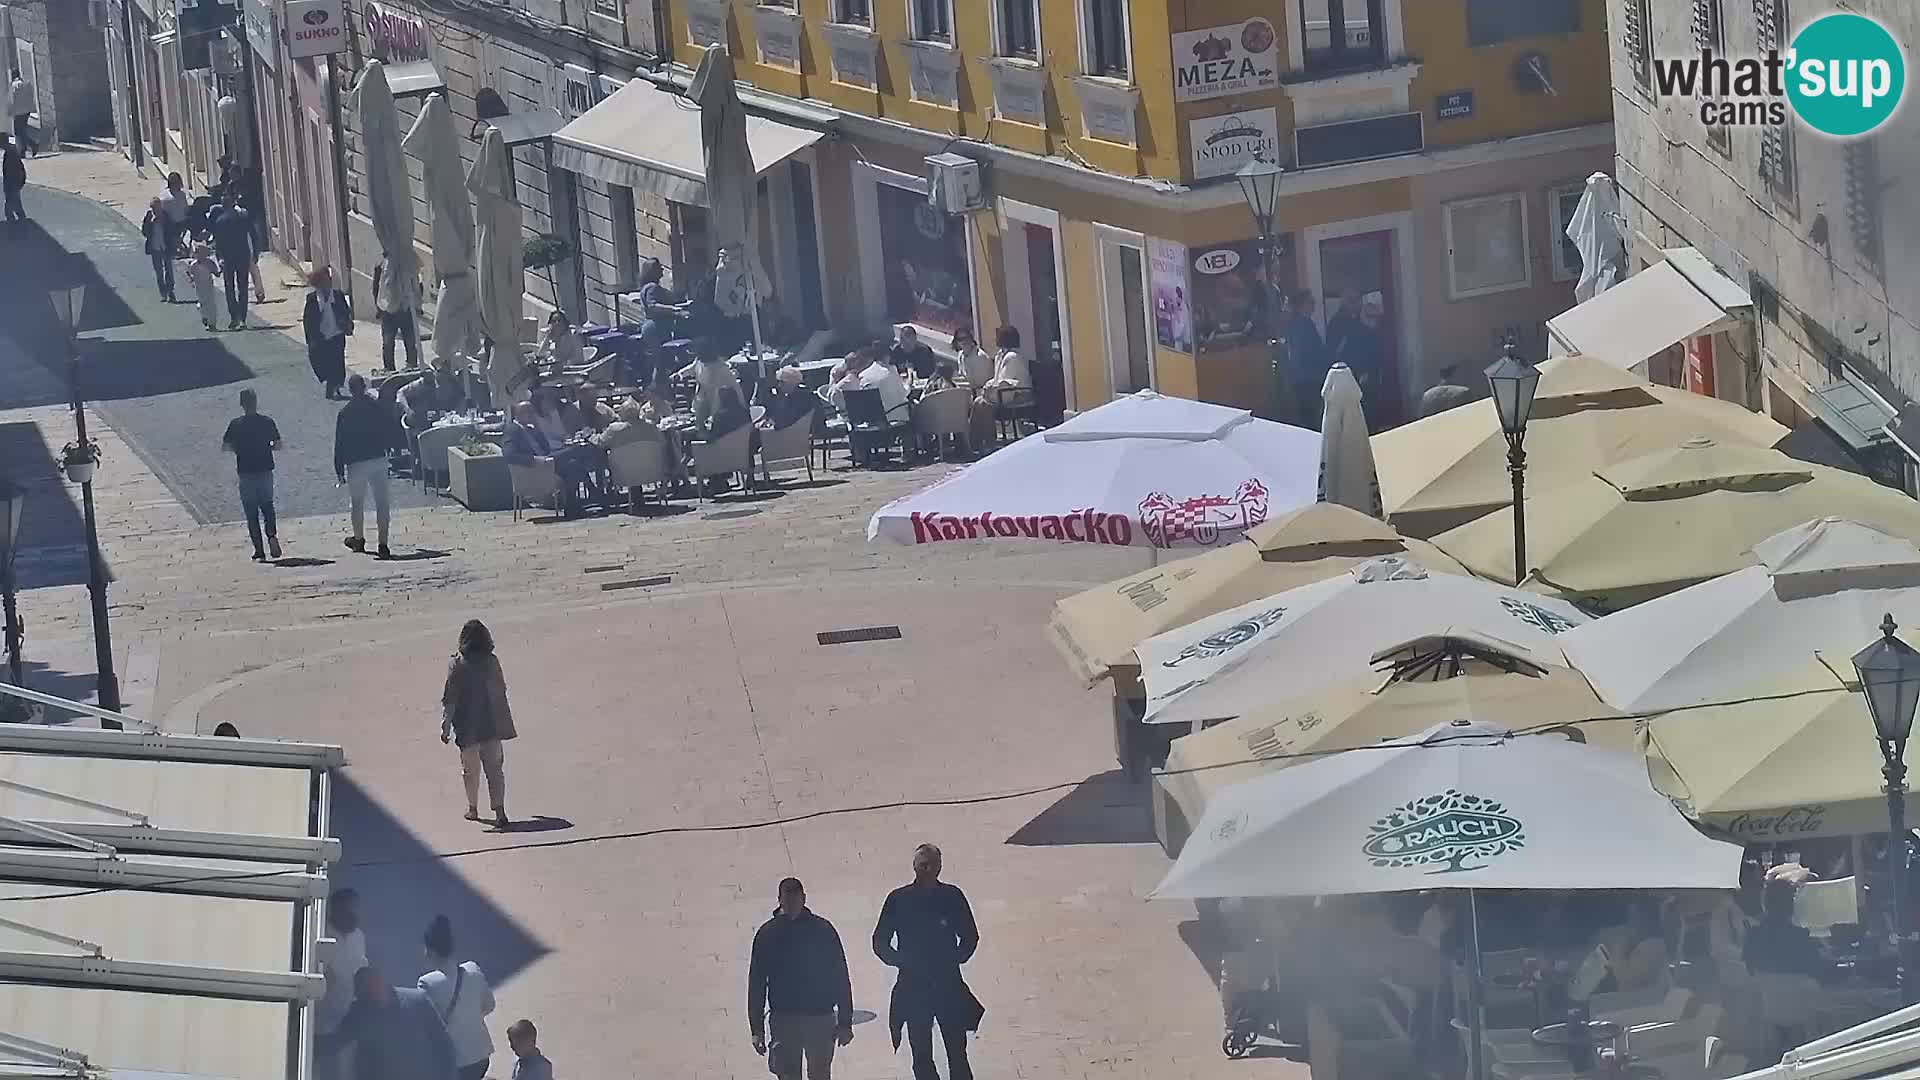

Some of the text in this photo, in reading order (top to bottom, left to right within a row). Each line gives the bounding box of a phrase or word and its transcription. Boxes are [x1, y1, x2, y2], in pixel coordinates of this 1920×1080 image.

[295, 27, 340, 41] SUKNO
[1178, 57, 1256, 87] MEZA
[1197, 143, 1242, 161] ISPOD
[911, 508, 1132, 546] Karlovačko
[1404, 819, 1502, 848] RAUCH
